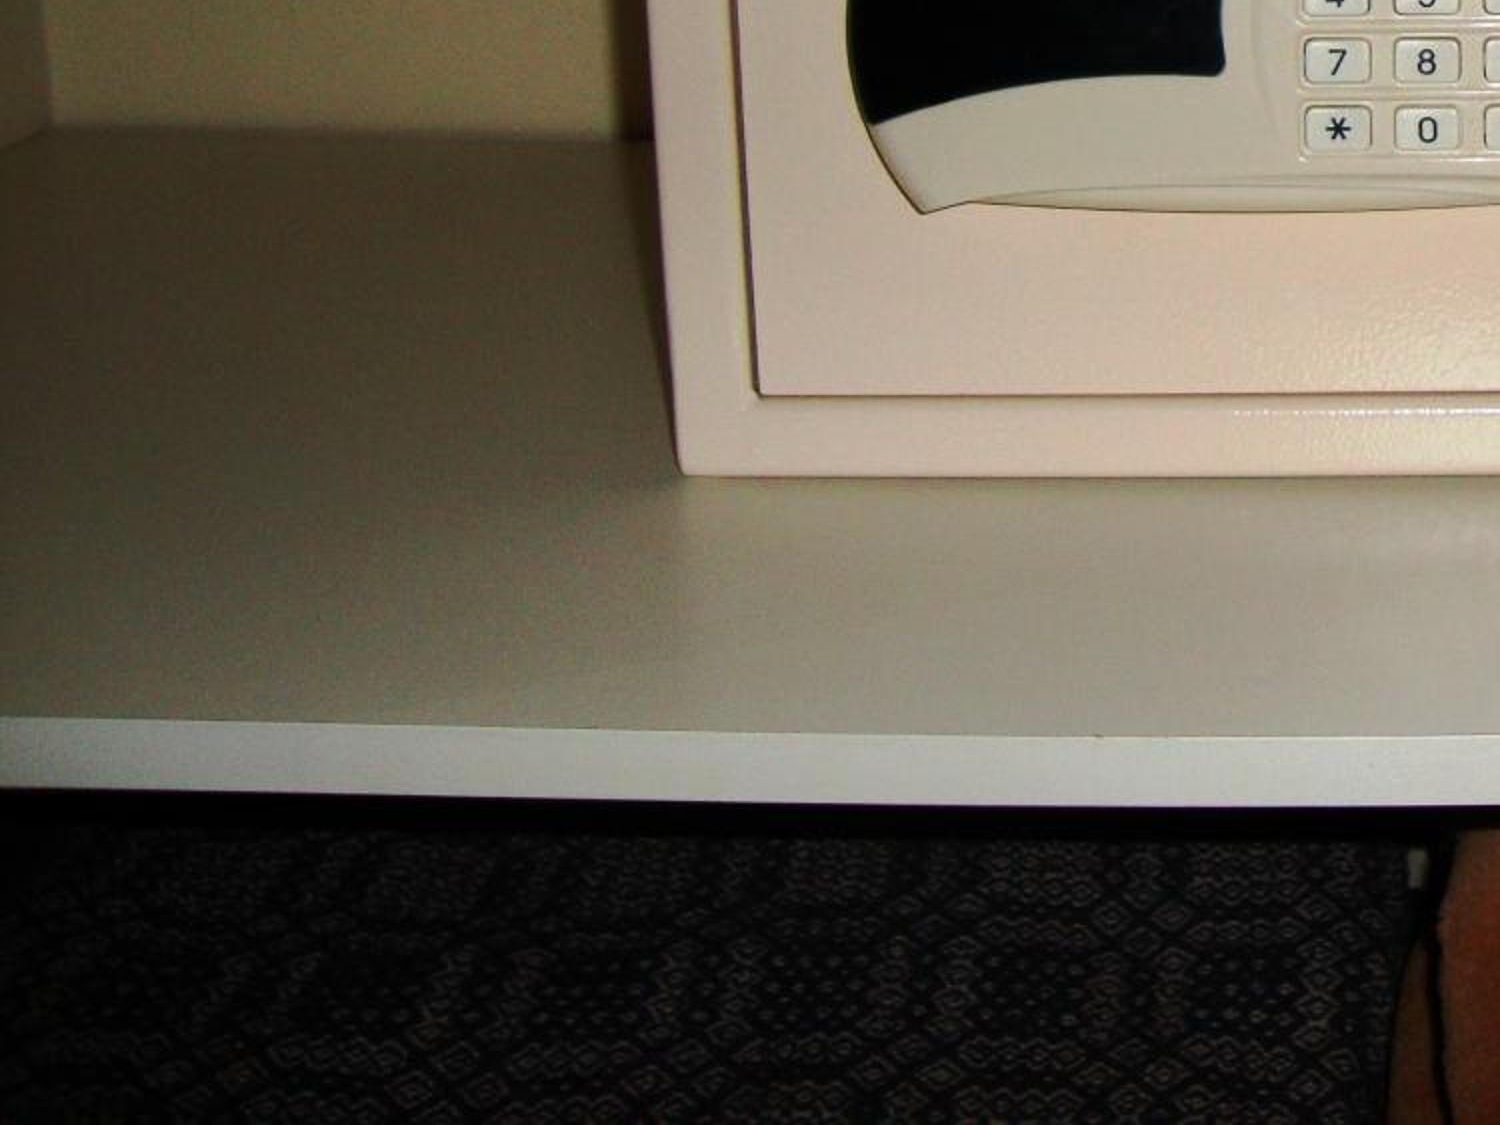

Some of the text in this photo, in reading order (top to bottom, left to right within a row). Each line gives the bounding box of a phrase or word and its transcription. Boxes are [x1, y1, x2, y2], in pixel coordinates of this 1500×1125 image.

[1328, 48, 1347, 76] 7
[1417, 48, 1437, 76] 8
[1418, 116, 1437, 143] 0
